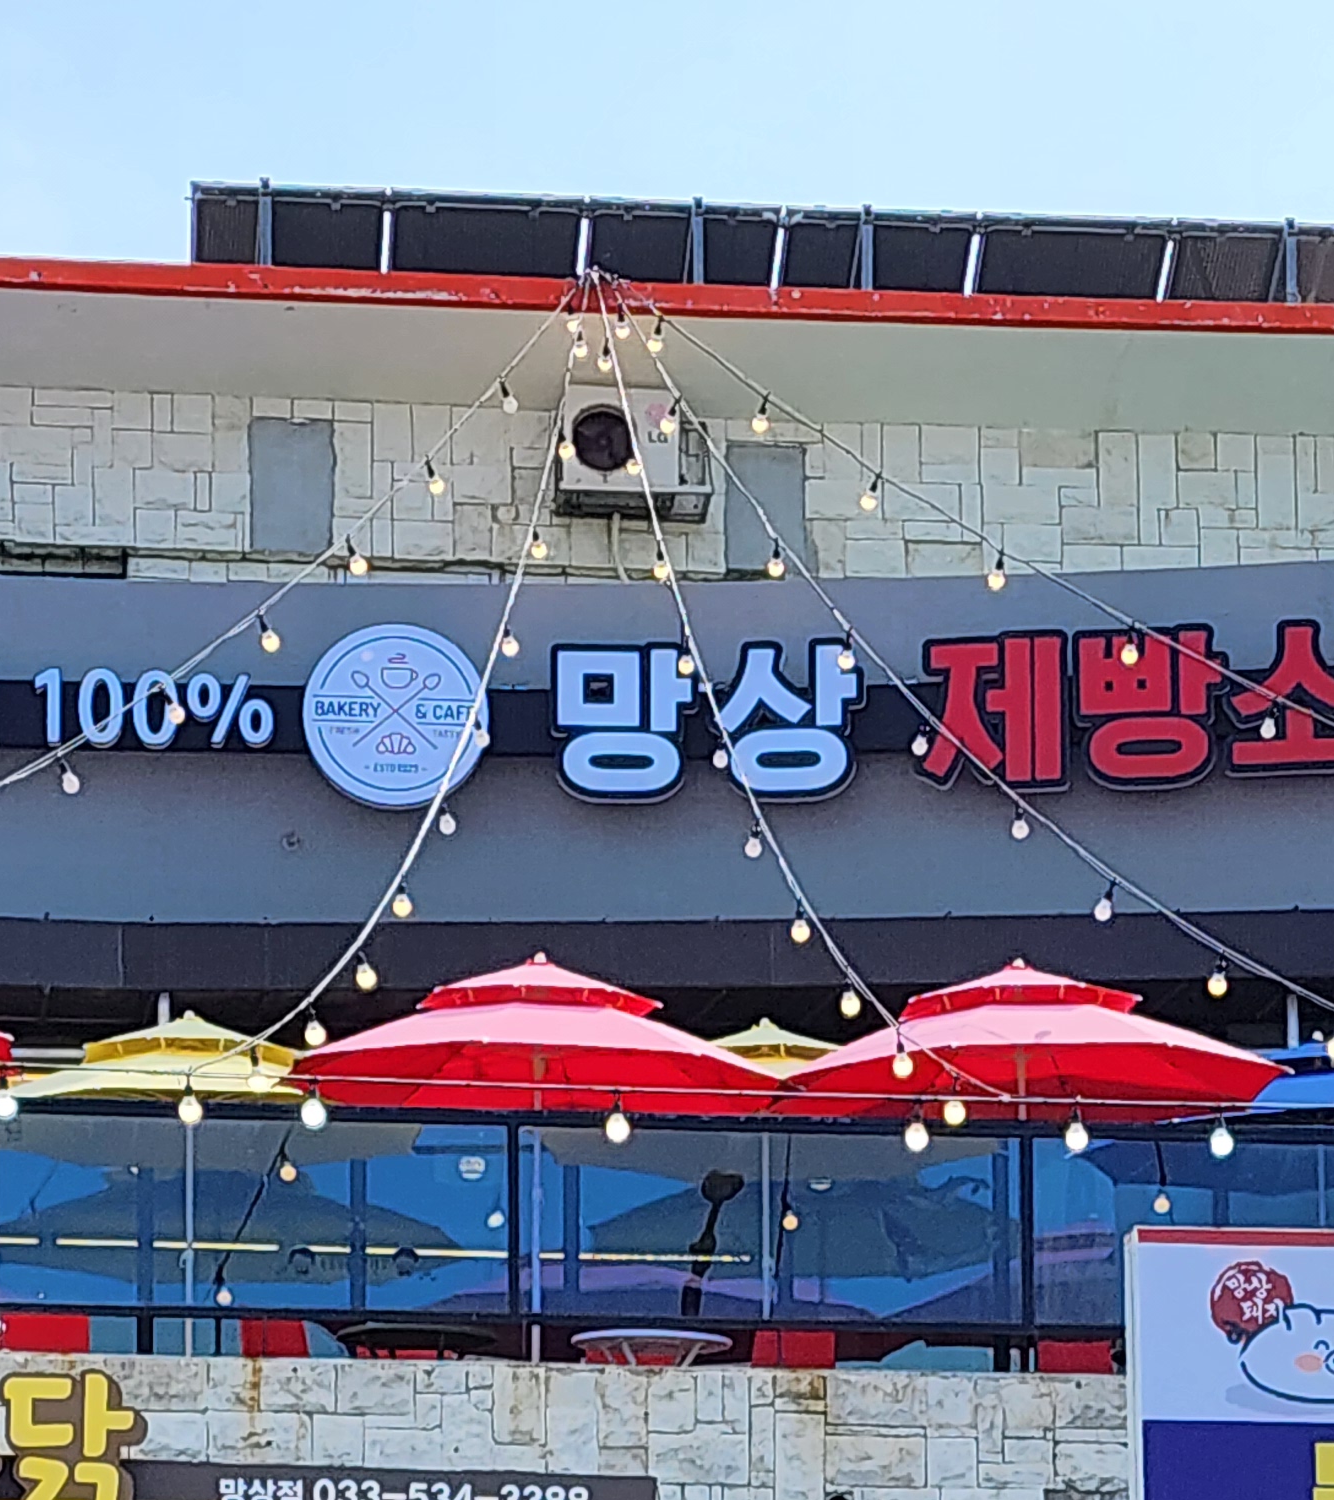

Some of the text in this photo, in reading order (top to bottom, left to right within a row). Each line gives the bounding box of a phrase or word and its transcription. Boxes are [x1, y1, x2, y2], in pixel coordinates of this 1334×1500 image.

[35, 673, 274, 750] 100%
[314, 701, 381, 717] BAKERY
[415, 704, 427, 719] &
[555, 640, 861, 794] 망상
